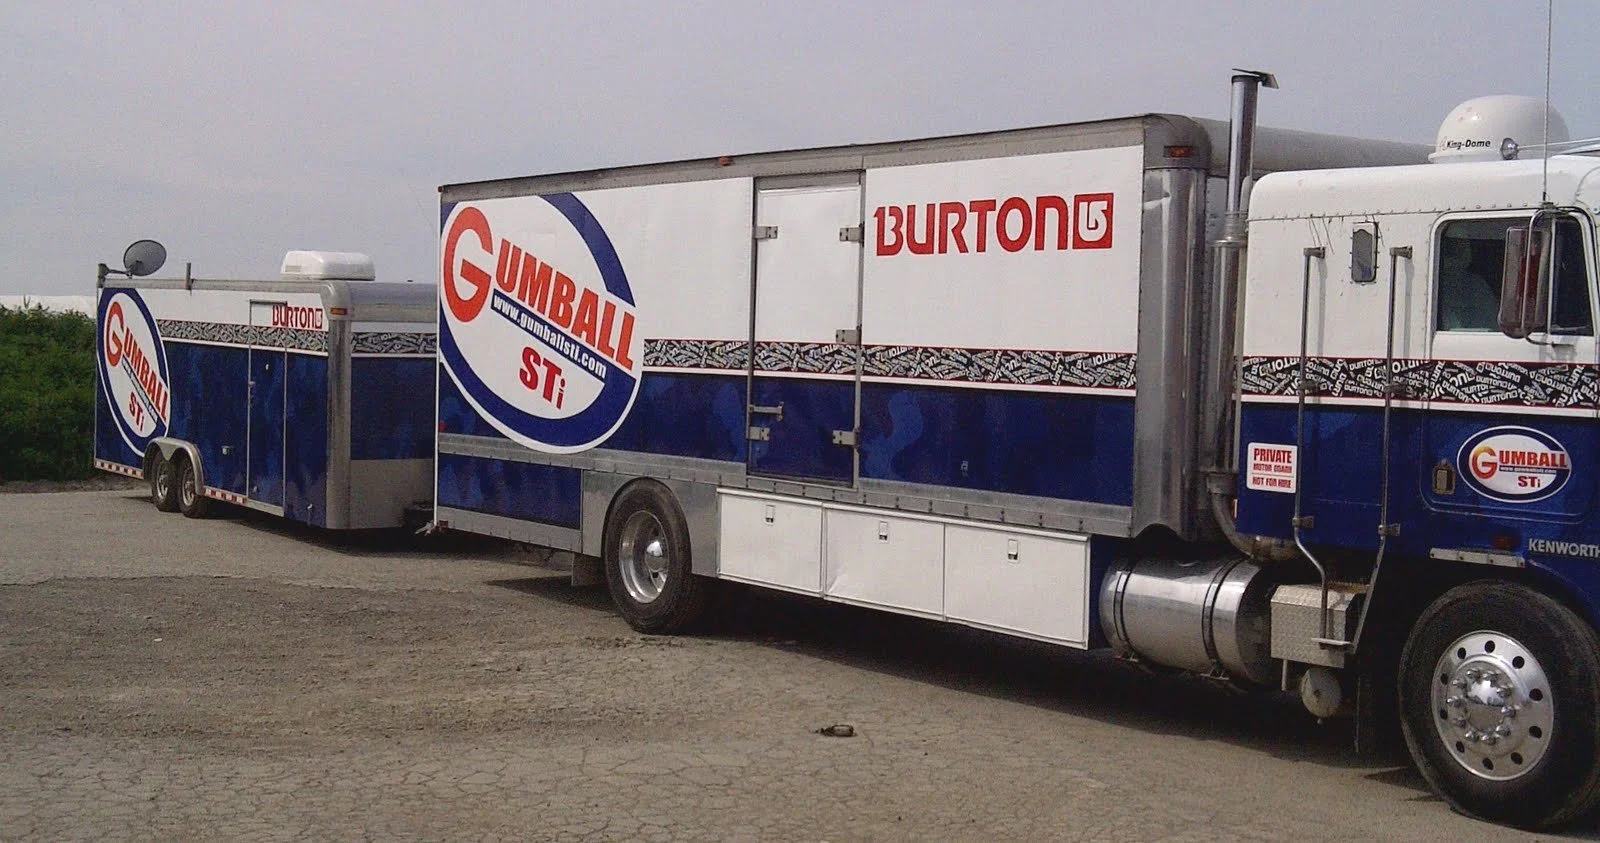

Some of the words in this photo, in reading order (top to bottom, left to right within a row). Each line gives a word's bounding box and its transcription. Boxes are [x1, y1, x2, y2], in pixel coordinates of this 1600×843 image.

[1446, 139, 1491, 150] King-Dome
[873, 196, 1068, 256] BURTON
[443, 206, 635, 371] GUMBALL
[272, 305, 315, 328] BURTON
[493, 294, 607, 378] www.gumballsti.com
[106, 301, 169, 423] GUMBALL
[1253, 447, 1292, 464] PRIVATE
[1472, 446, 1567, 480] GUMBALL
[1252, 476, 1264, 485] NOT
[1266, 478, 1277, 487] FOR
